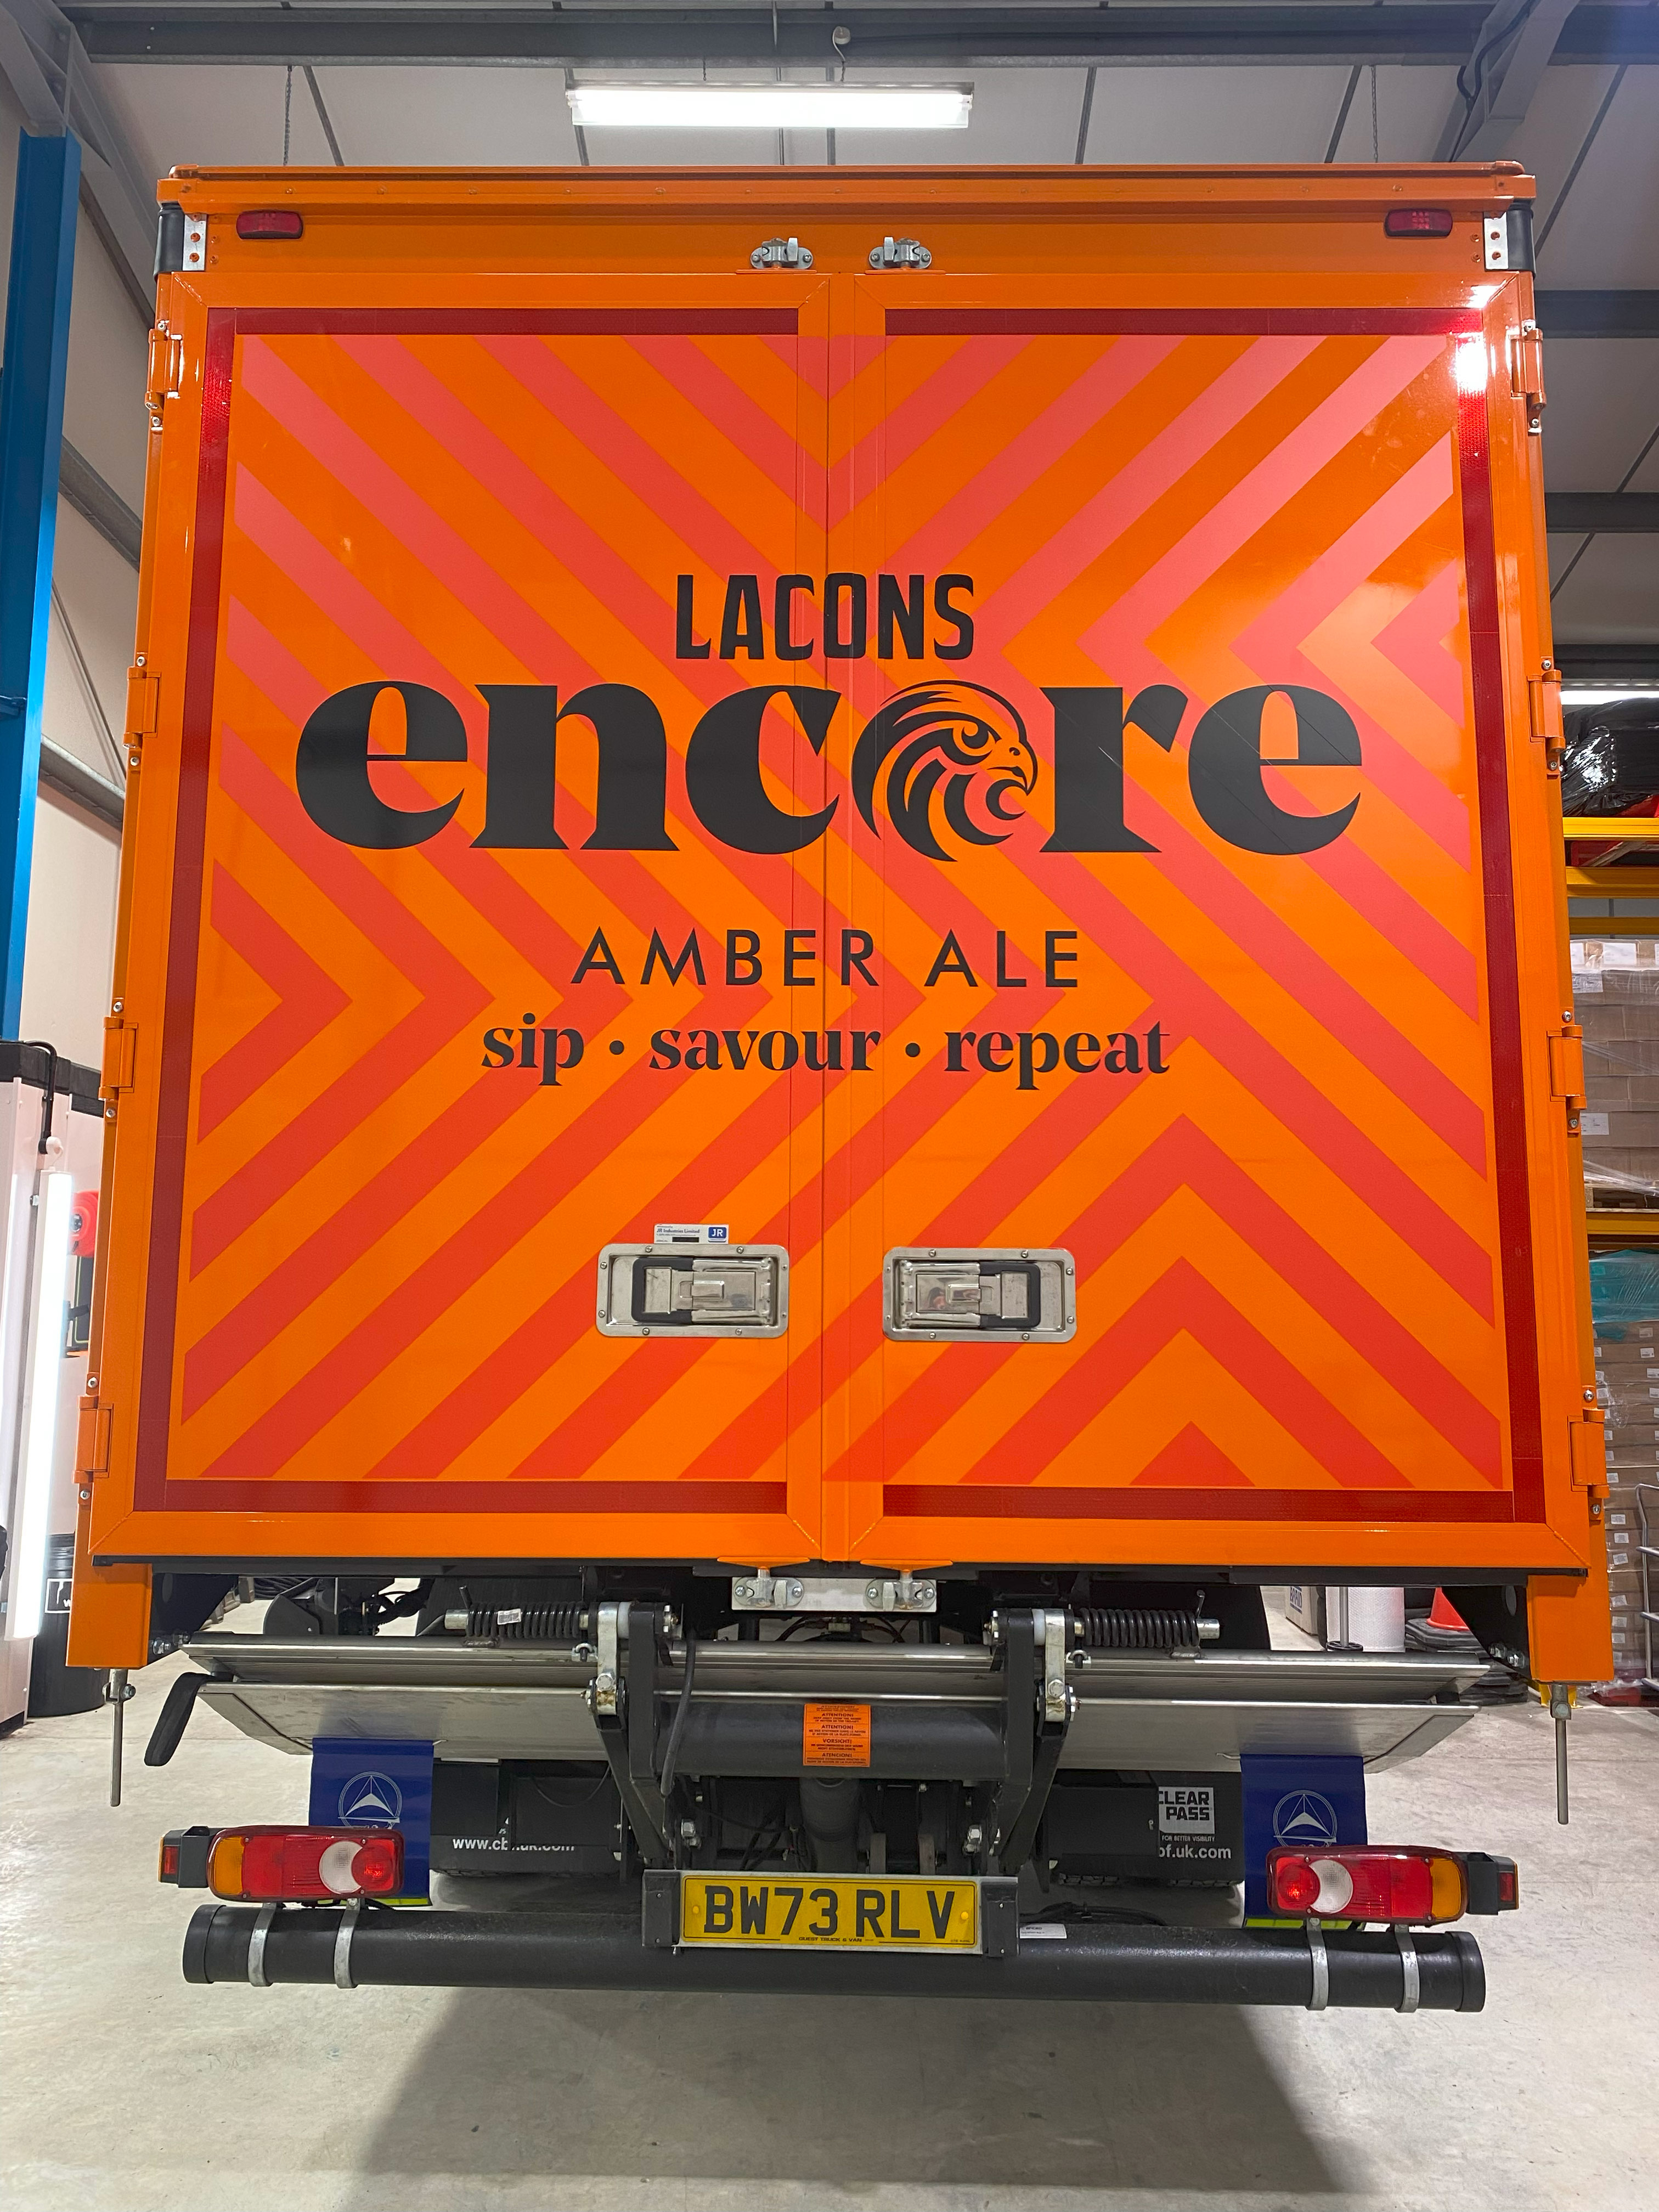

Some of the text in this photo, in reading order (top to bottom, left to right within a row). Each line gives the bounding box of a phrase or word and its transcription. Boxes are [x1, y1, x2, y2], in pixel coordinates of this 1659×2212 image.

[676, 573, 974, 661] LACONS
[296, 681, 1362, 862] encore
[571, 927, 1077, 987] AMBER ALE
[481, 1013, 1171, 1090] sip savour repeat
[712, 1229, 723, 1237] JR
[1166, 1807, 1210, 1821] PASS
[704, 1885, 955, 1939] BW73 RLV
